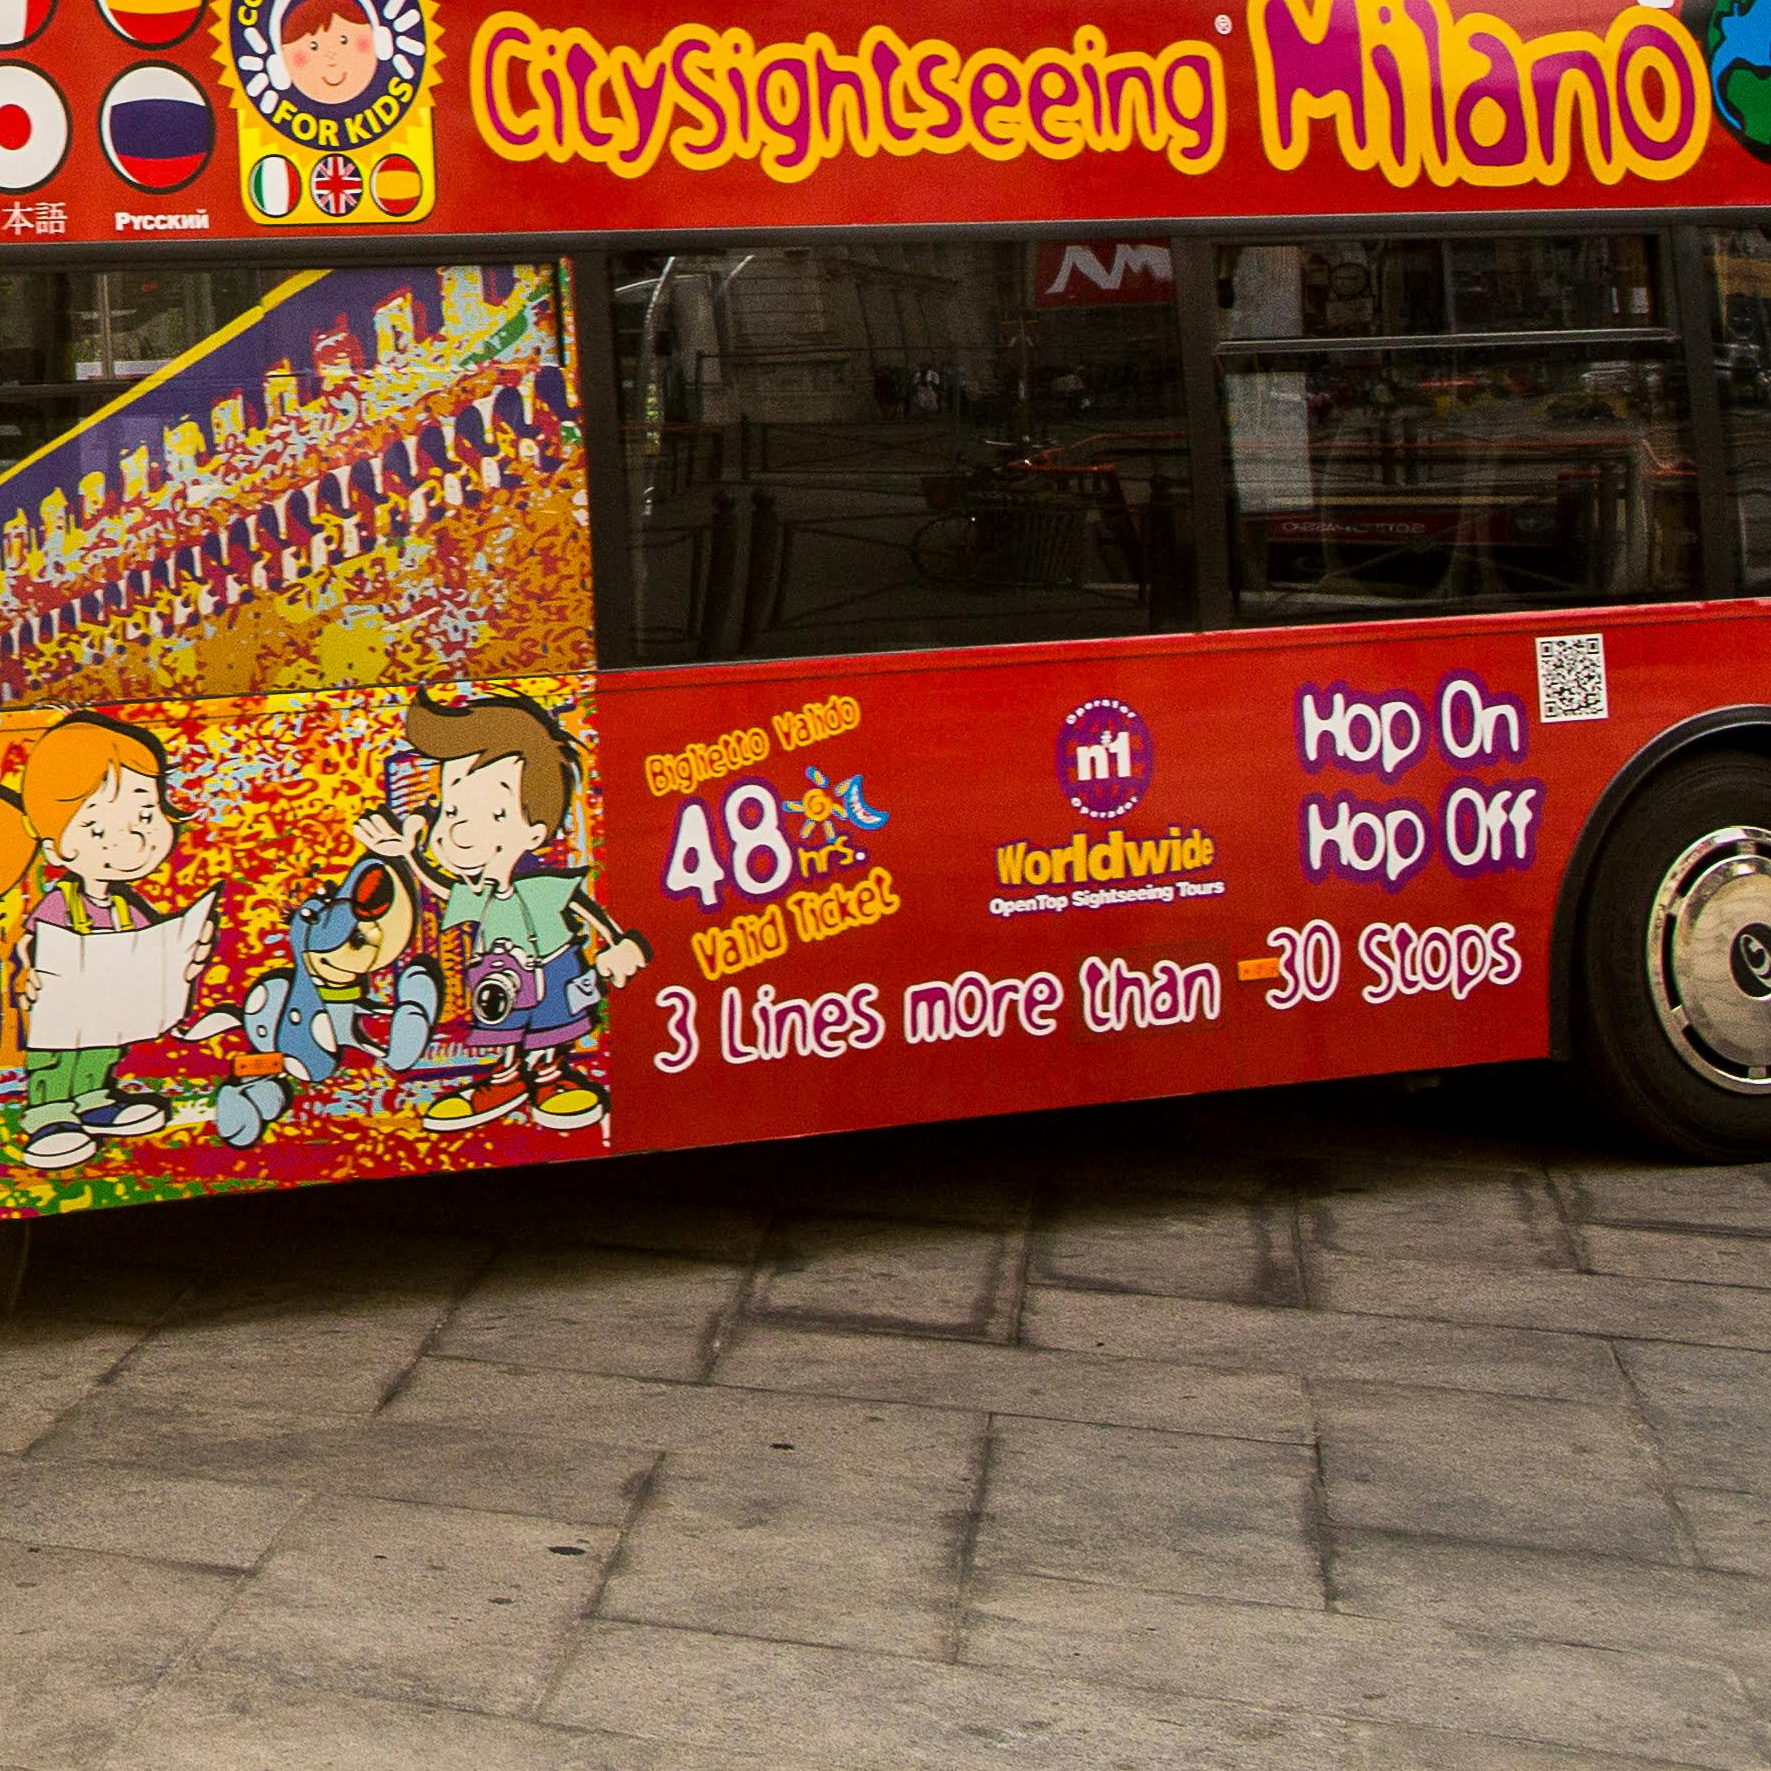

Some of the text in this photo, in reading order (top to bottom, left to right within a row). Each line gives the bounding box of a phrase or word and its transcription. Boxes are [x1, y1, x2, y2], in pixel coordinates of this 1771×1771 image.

[272, 76, 413, 147] FOR KIDS
[470, 11, 1226, 183] CitySightseeing
[115, 208, 210, 232] Русский
[645, 695, 861, 796] Biglietto Valido
[1065, 699, 1137, 724] Operator
[1303, 680, 1519, 772] Hop On
[666, 784, 792, 905] 48
[996, 827, 1215, 886] Worldwide
[1308, 787, 1537, 880] Hop Off
[691, 867, 900, 981] Valid Ticket
[989, 881, 1225, 917] OpenTop Sightseeing Tours
[653, 919, 1522, 1073] 3 Lines more than 30 Stops
